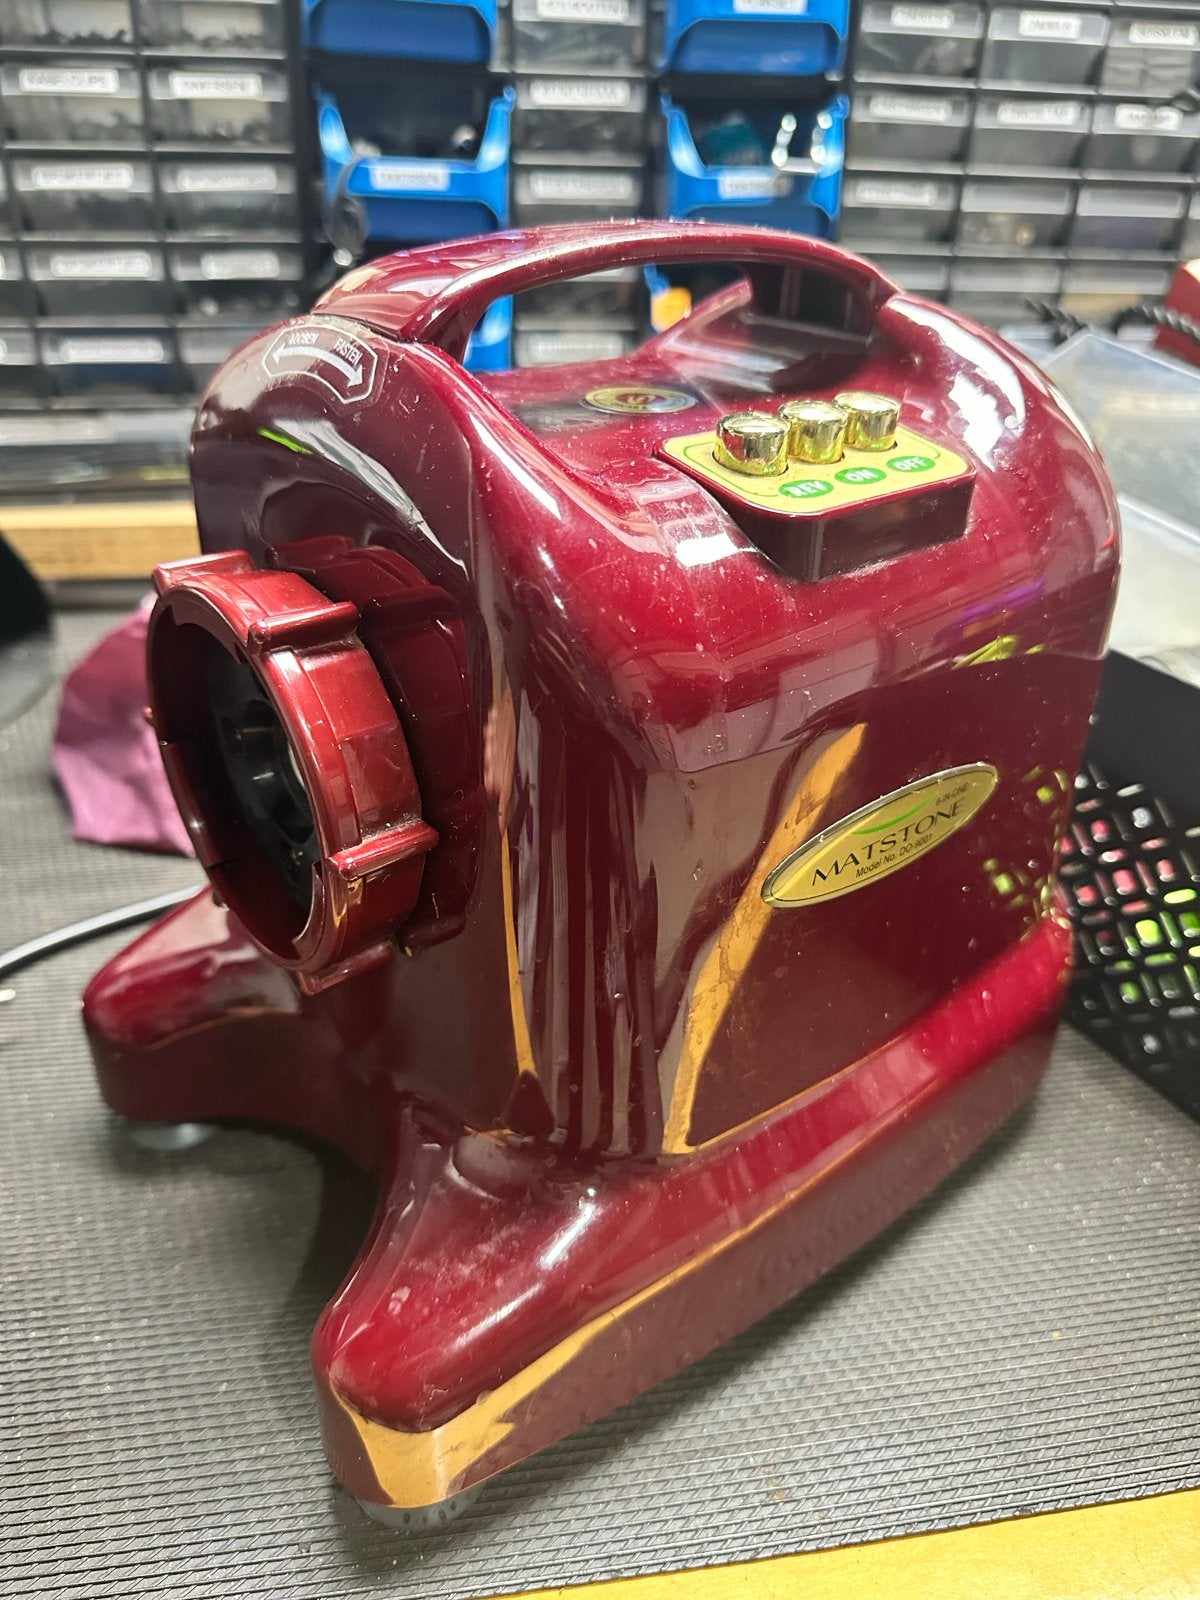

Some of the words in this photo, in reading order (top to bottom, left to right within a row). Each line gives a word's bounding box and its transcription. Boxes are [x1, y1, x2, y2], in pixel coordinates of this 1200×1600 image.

[333, 338, 363, 366] FASTEN
[893, 457, 928, 471] OFF
[844, 469, 878, 482] ON
[785, 481, 826, 497] REV
[811, 798, 966, 886] MATSTONE
[856, 858, 882, 878] Model
